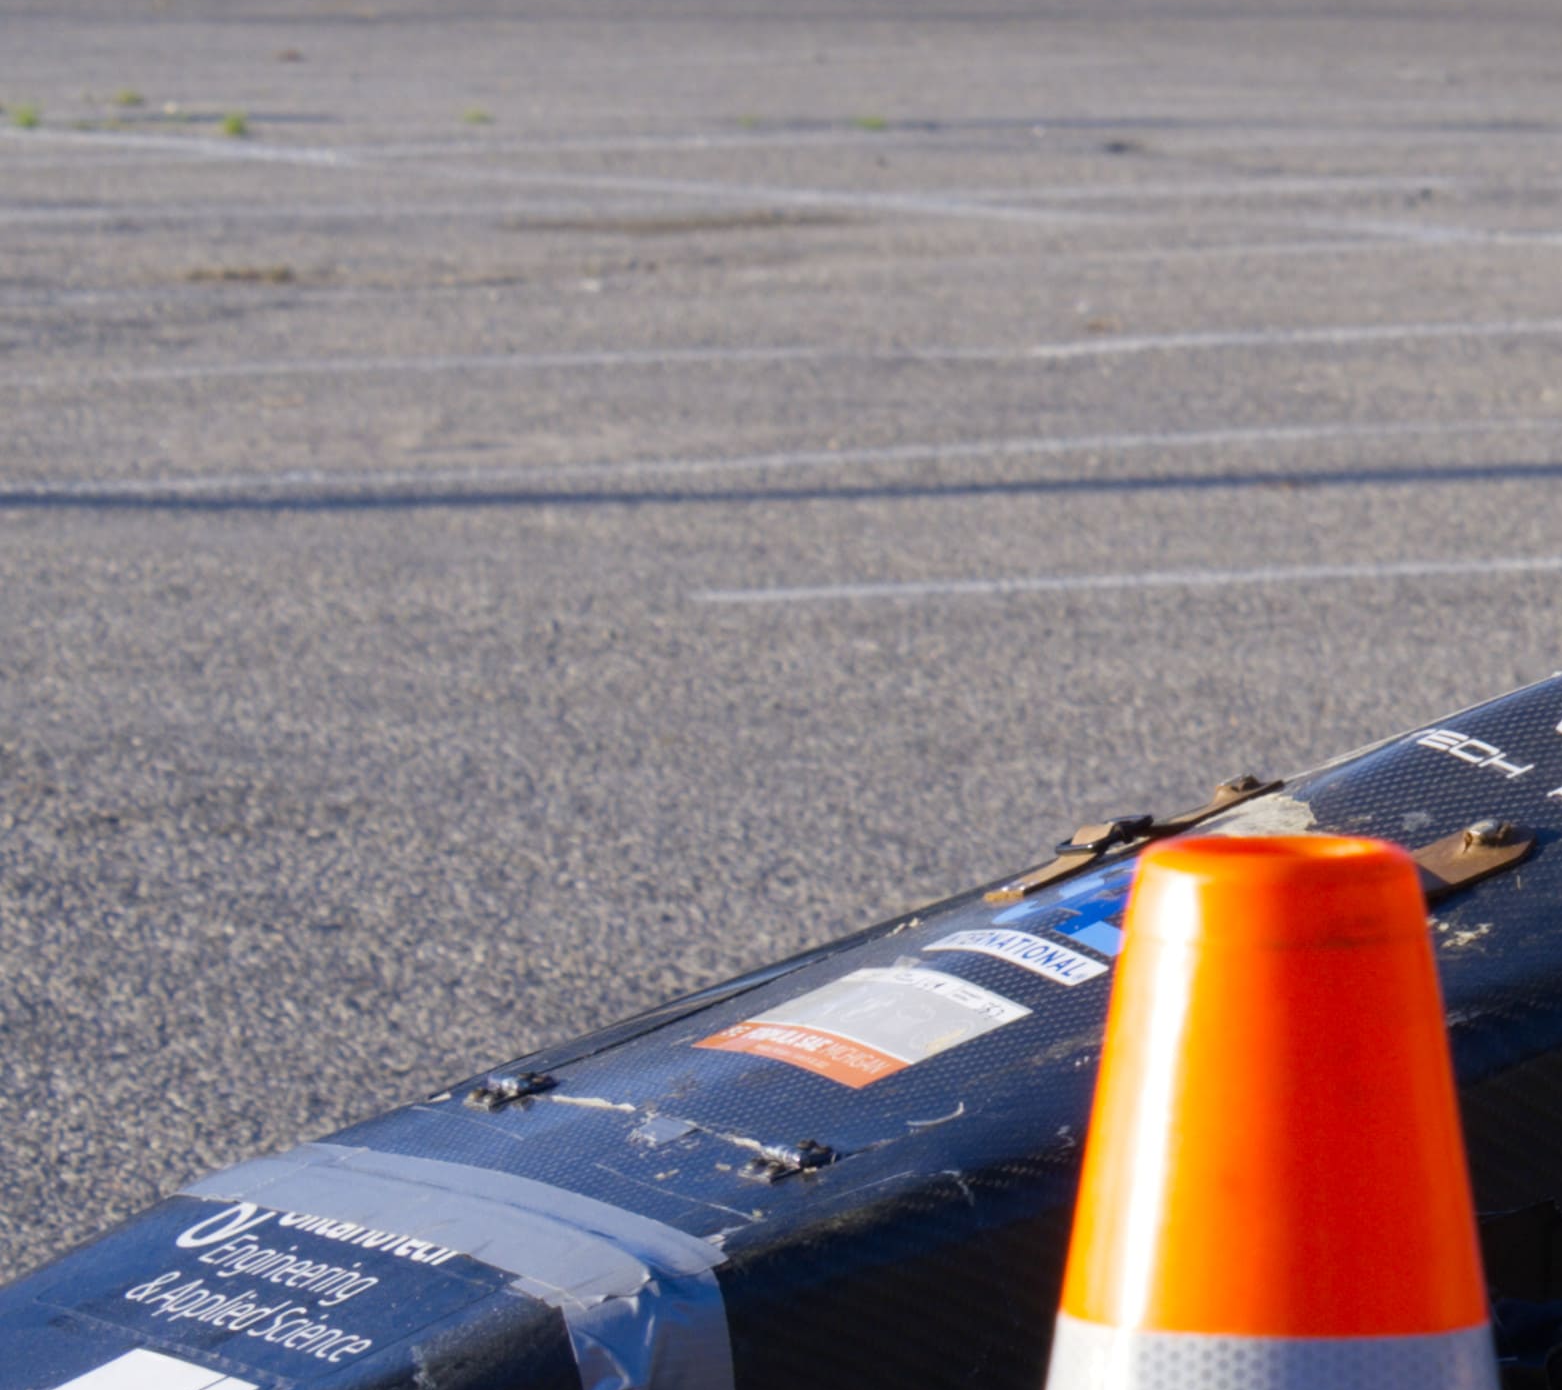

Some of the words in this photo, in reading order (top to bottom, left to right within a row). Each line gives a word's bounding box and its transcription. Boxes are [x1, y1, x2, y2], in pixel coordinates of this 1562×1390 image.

[198, 1234, 380, 1307] Engineering
[150, 1278, 292, 1336] Applied
[246, 1305, 373, 1363] Science
